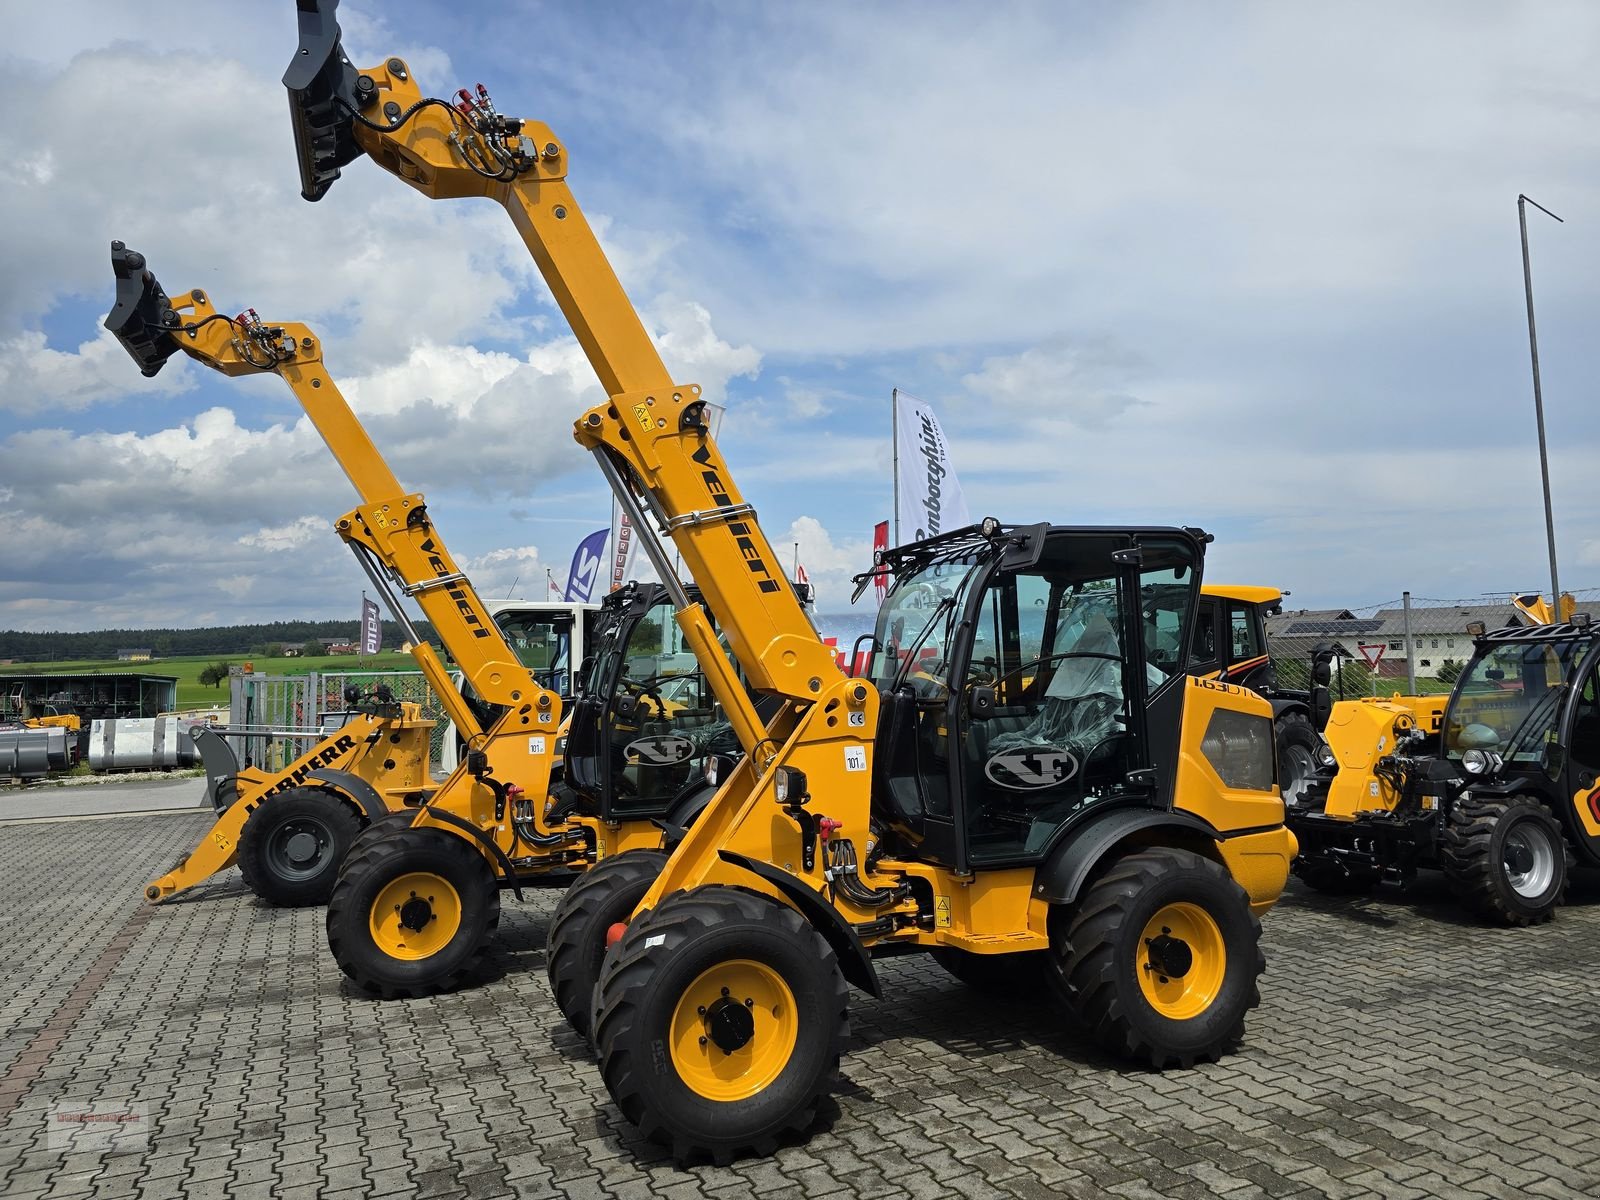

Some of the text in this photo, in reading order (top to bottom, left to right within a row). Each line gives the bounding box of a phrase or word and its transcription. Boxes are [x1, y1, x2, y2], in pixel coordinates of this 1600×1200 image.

[915, 410, 946, 542] mborghini
[691, 444, 782, 594] VENIERI
[850, 713, 863, 725] CE
[530, 744, 540, 753] 101
[847, 757, 860, 769] 101
